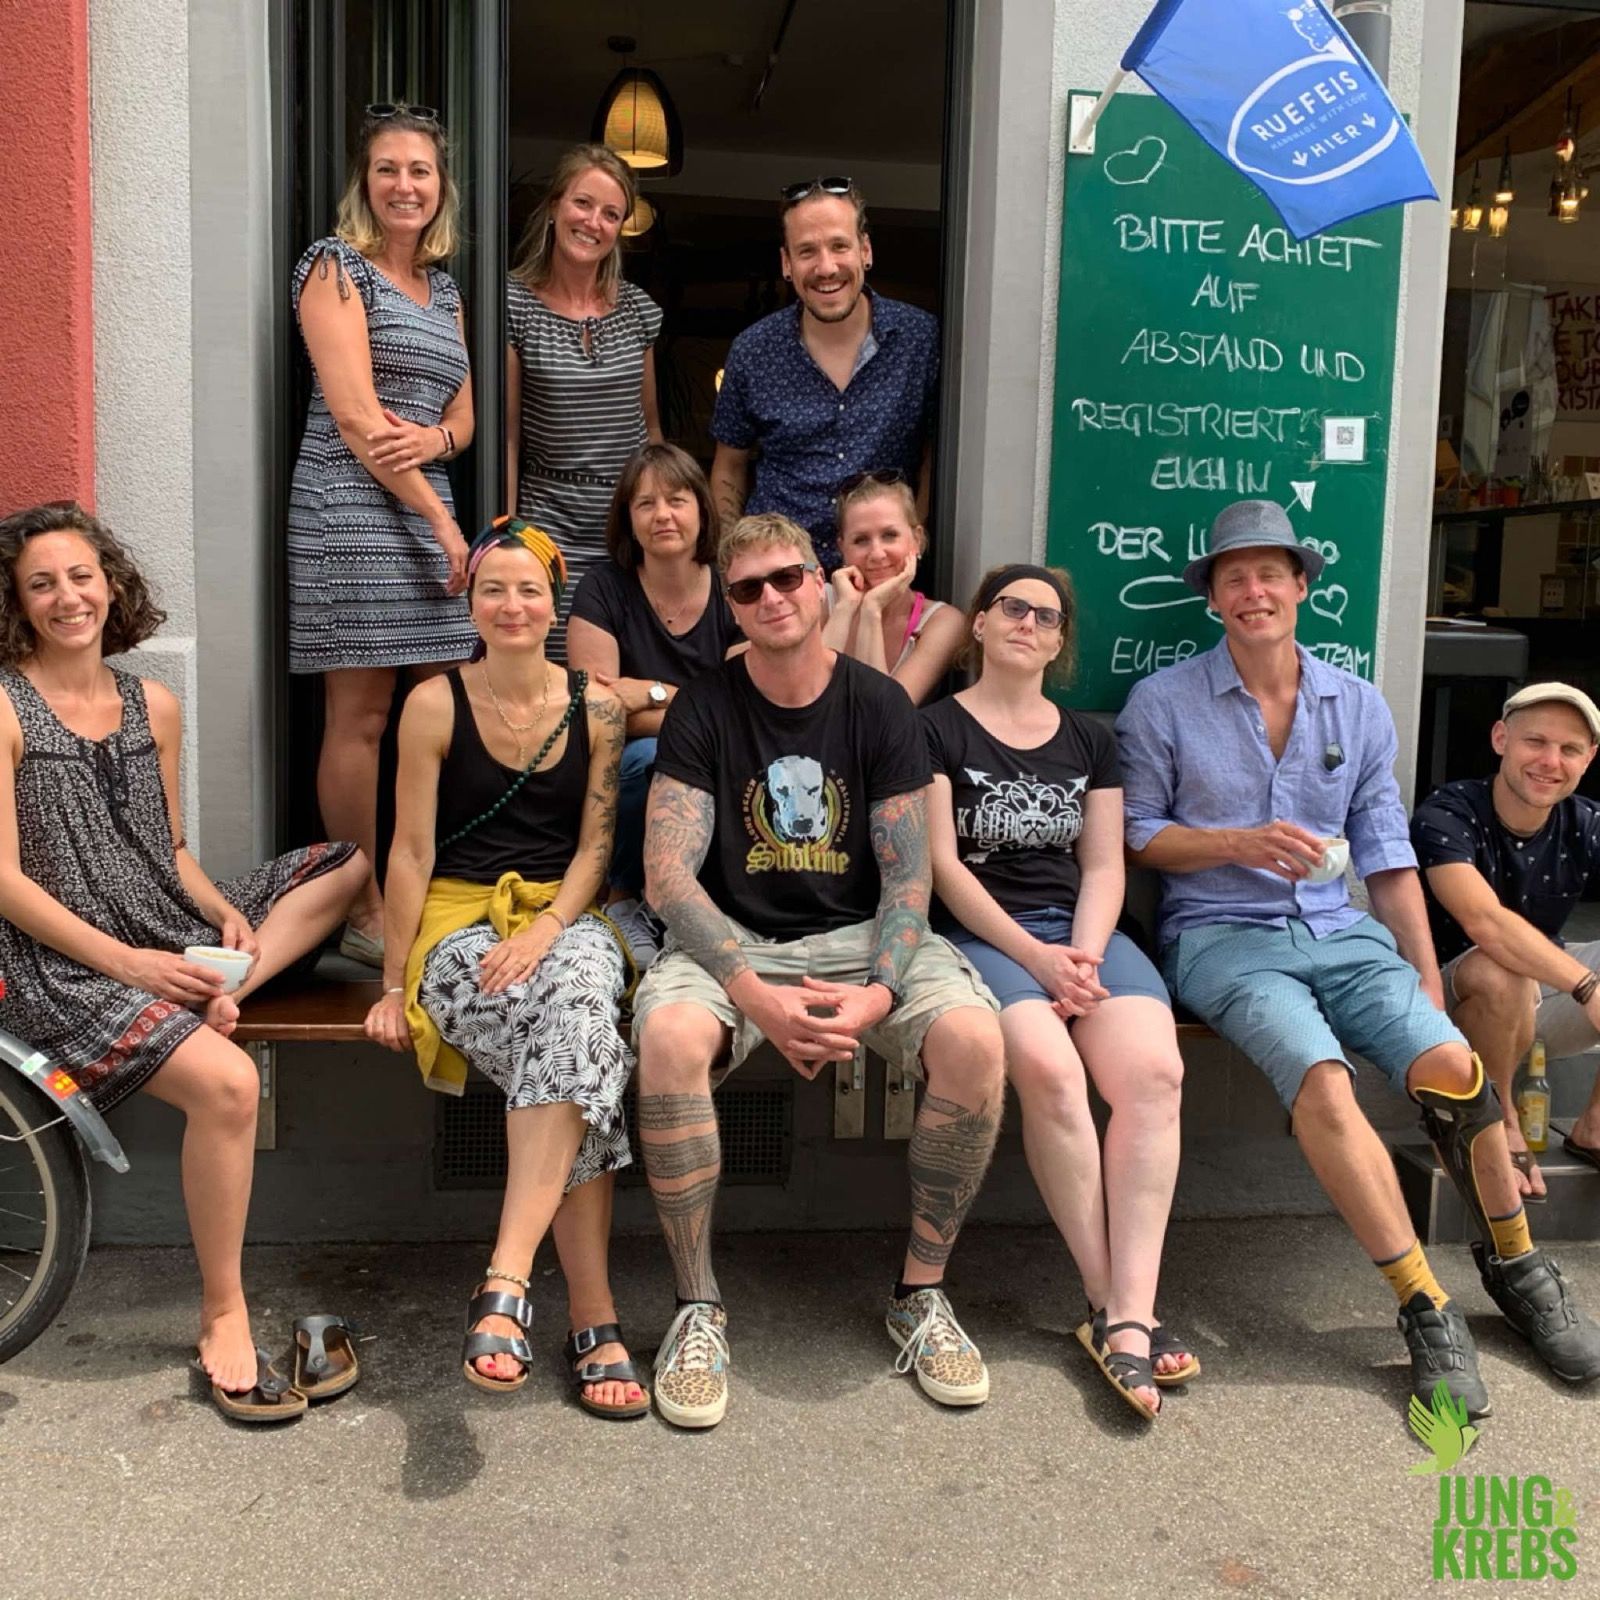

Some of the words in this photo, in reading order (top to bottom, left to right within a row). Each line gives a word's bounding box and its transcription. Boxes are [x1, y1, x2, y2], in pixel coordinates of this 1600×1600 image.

[1250, 70, 1358, 141] RUEFEIS
[1310, 124, 1362, 157] HIER
[1113, 213, 1226, 253] BITTE
[1238, 223, 1383, 272] ACHTET
[1191, 271, 1261, 314] AUF
[1120, 328, 1284, 373] ABSTAND
[1300, 344, 1366, 383] UND
[1071, 398, 1301, 443] REGISTRIERT
[1151, 456, 1227, 492] EUCH
[1236, 458, 1273, 495] IN
[1088, 521, 1173, 562] DER
[1111, 636, 1198, 674] EUER
[834, 778, 853, 843] CALIFORNIA
[745, 841, 851, 876] Sublime
